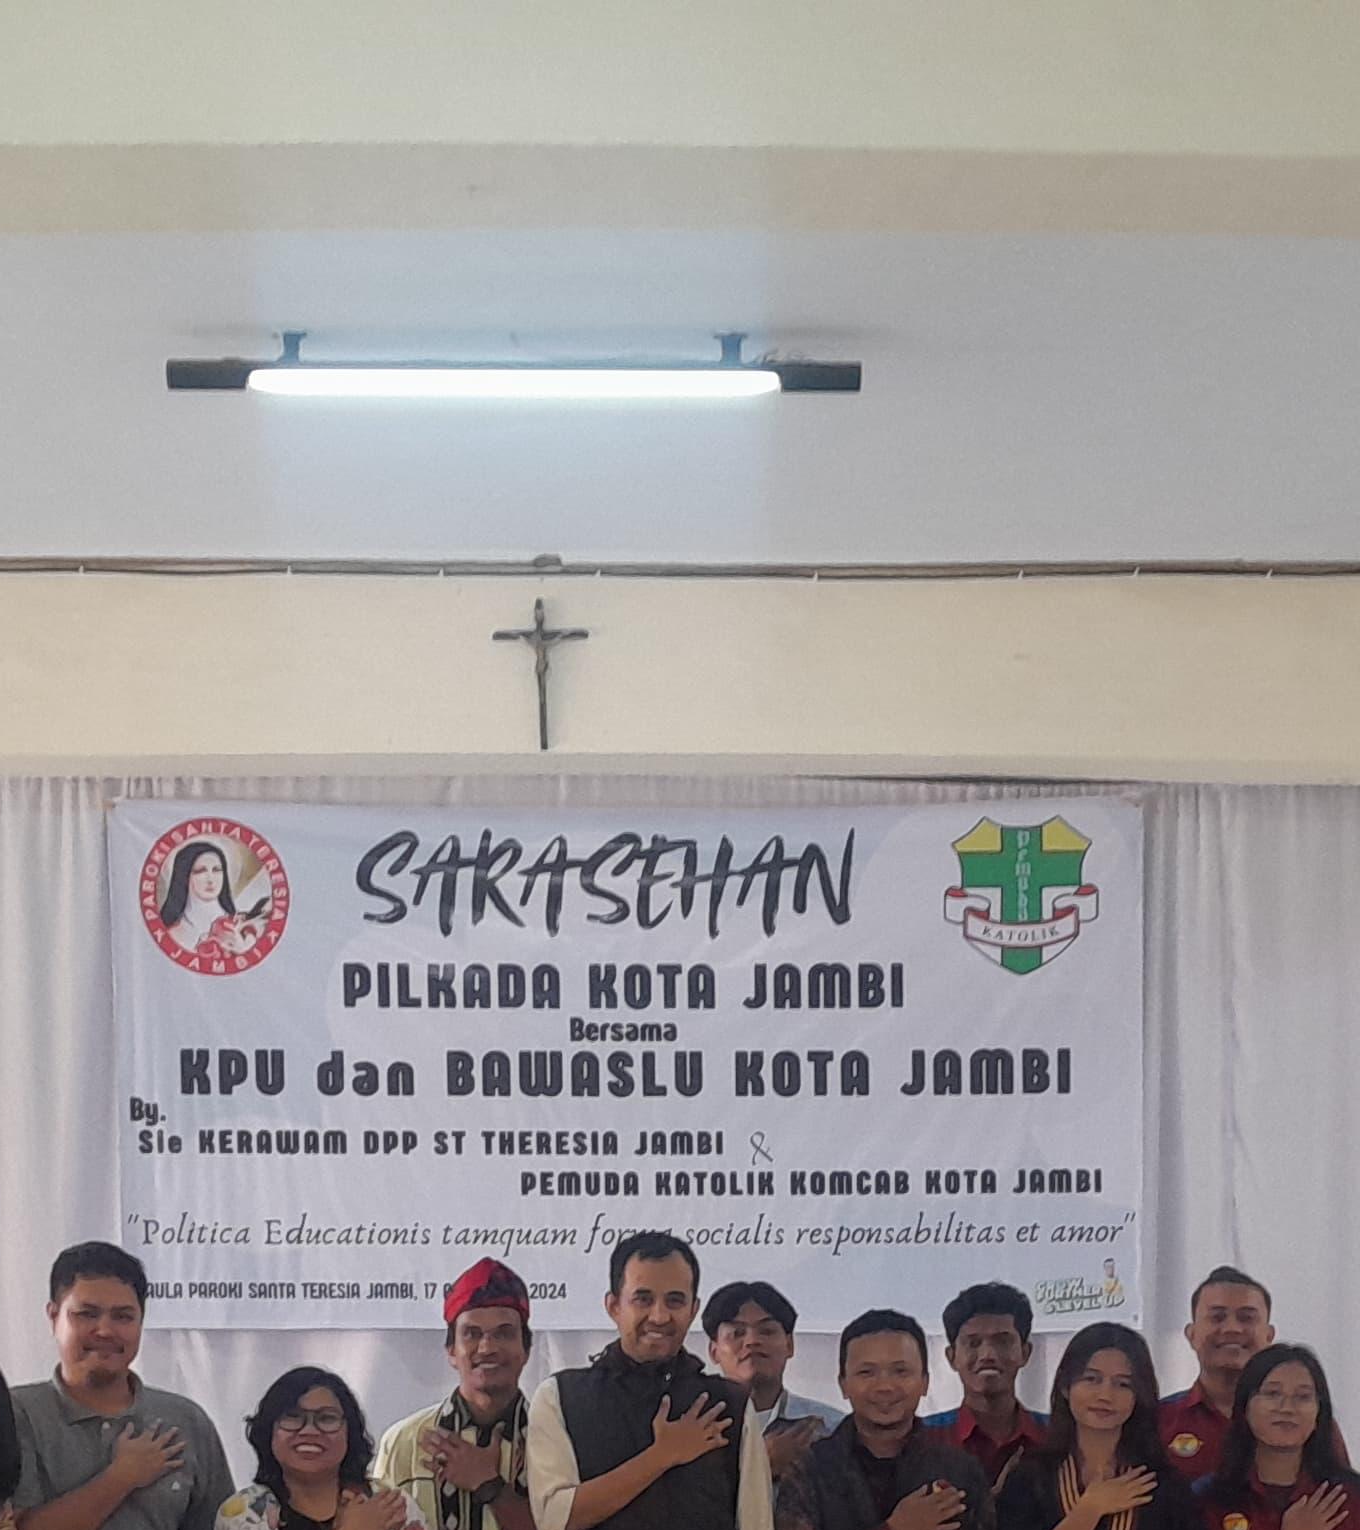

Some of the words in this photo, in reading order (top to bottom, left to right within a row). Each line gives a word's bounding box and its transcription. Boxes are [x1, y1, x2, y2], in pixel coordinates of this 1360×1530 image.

[142, 841, 171, 921] PAROKI
[170, 821, 242, 844] SANTA
[247, 834, 287, 921] TERESIA
[355, 827, 855, 939] SARASEHAN
[982, 925, 1060, 942] KATOLIK
[170, 948, 264, 973] JAMBI
[342, 962, 561, 1010] PILKADA
[588, 963, 716, 1010] KOTA
[742, 962, 904, 1009] JAMBI
[569, 1016, 678, 1042] Bersama
[179, 1047, 285, 1097] KPU
[316, 1050, 415, 1097] dan
[446, 1050, 703, 1098] BAWASLU
[734, 1050, 870, 1098] KOTA
[900, 1047, 1071, 1096] JAMBI
[129, 1096, 166, 1127] By.
[198, 1129, 348, 1155] KERAWAM
[363, 1130, 418, 1155] DPP
[433, 1130, 466, 1156] ST
[481, 1130, 618, 1156] THERESIA
[634, 1130, 724, 1156] JAMBI
[749, 1131, 774, 1166] &
[520, 1171, 640, 1197] PEMUDA
[655, 1171, 775, 1197] KATOLIK
[790, 1170, 910, 1196] KOMCAB
[925, 1169, 997, 1195] KOTA
[1012, 1168, 1102, 1194] JAMBI
[264, 1212, 431, 1245] Educationis
[442, 1222, 579, 1258] tamquam
[686, 1213, 785, 1246] socialis
[796, 1211, 1006, 1257] responsabilitas
[1015, 1222, 1041, 1244] et
[146, 1281, 183, 1299] AULA
[188, 1281, 243, 1299] PAROKI
[248, 1282, 297, 1300] SANTA
[301, 1282, 361, 1300] TERESIA
[366, 1282, 418, 1302] JAMBI,
[423, 1282, 438, 1300] 17
[529, 1282, 567, 1300] 2024
